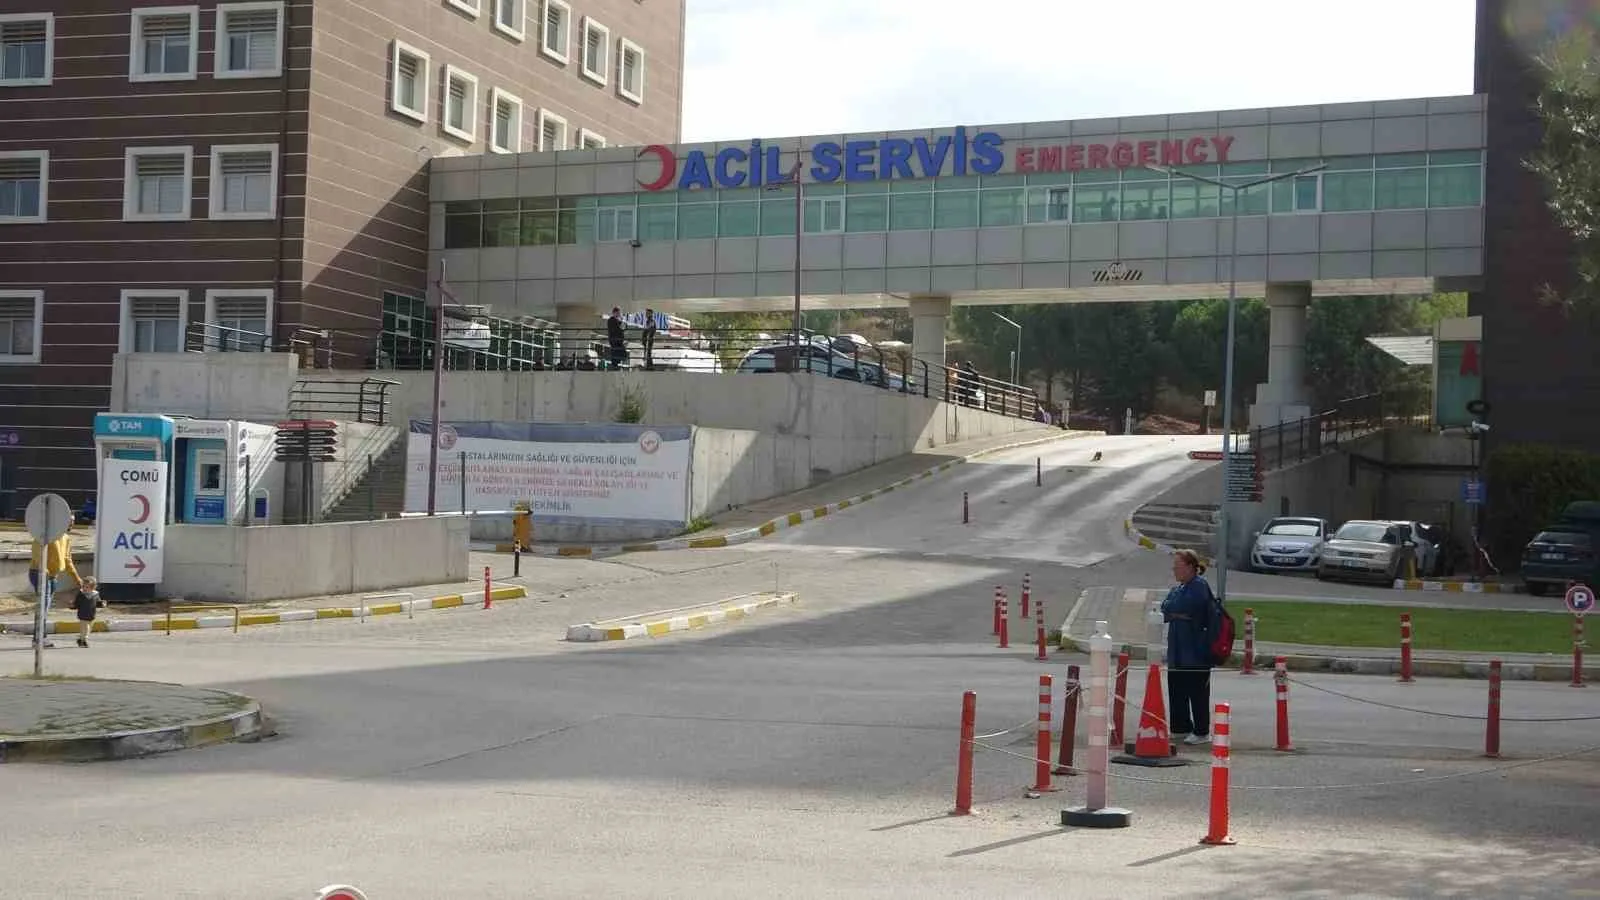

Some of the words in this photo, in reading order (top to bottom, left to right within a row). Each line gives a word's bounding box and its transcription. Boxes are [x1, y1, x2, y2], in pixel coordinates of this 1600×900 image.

[678, 138, 795, 189] ACİL
[810, 125, 1005, 183] SERVİS
[1016, 135, 1235, 174] EMERGENCY
[120, 469, 160, 485] ÇOMÜ
[113, 528, 158, 550] ACİL
[1573, 591, 1588, 607] P
